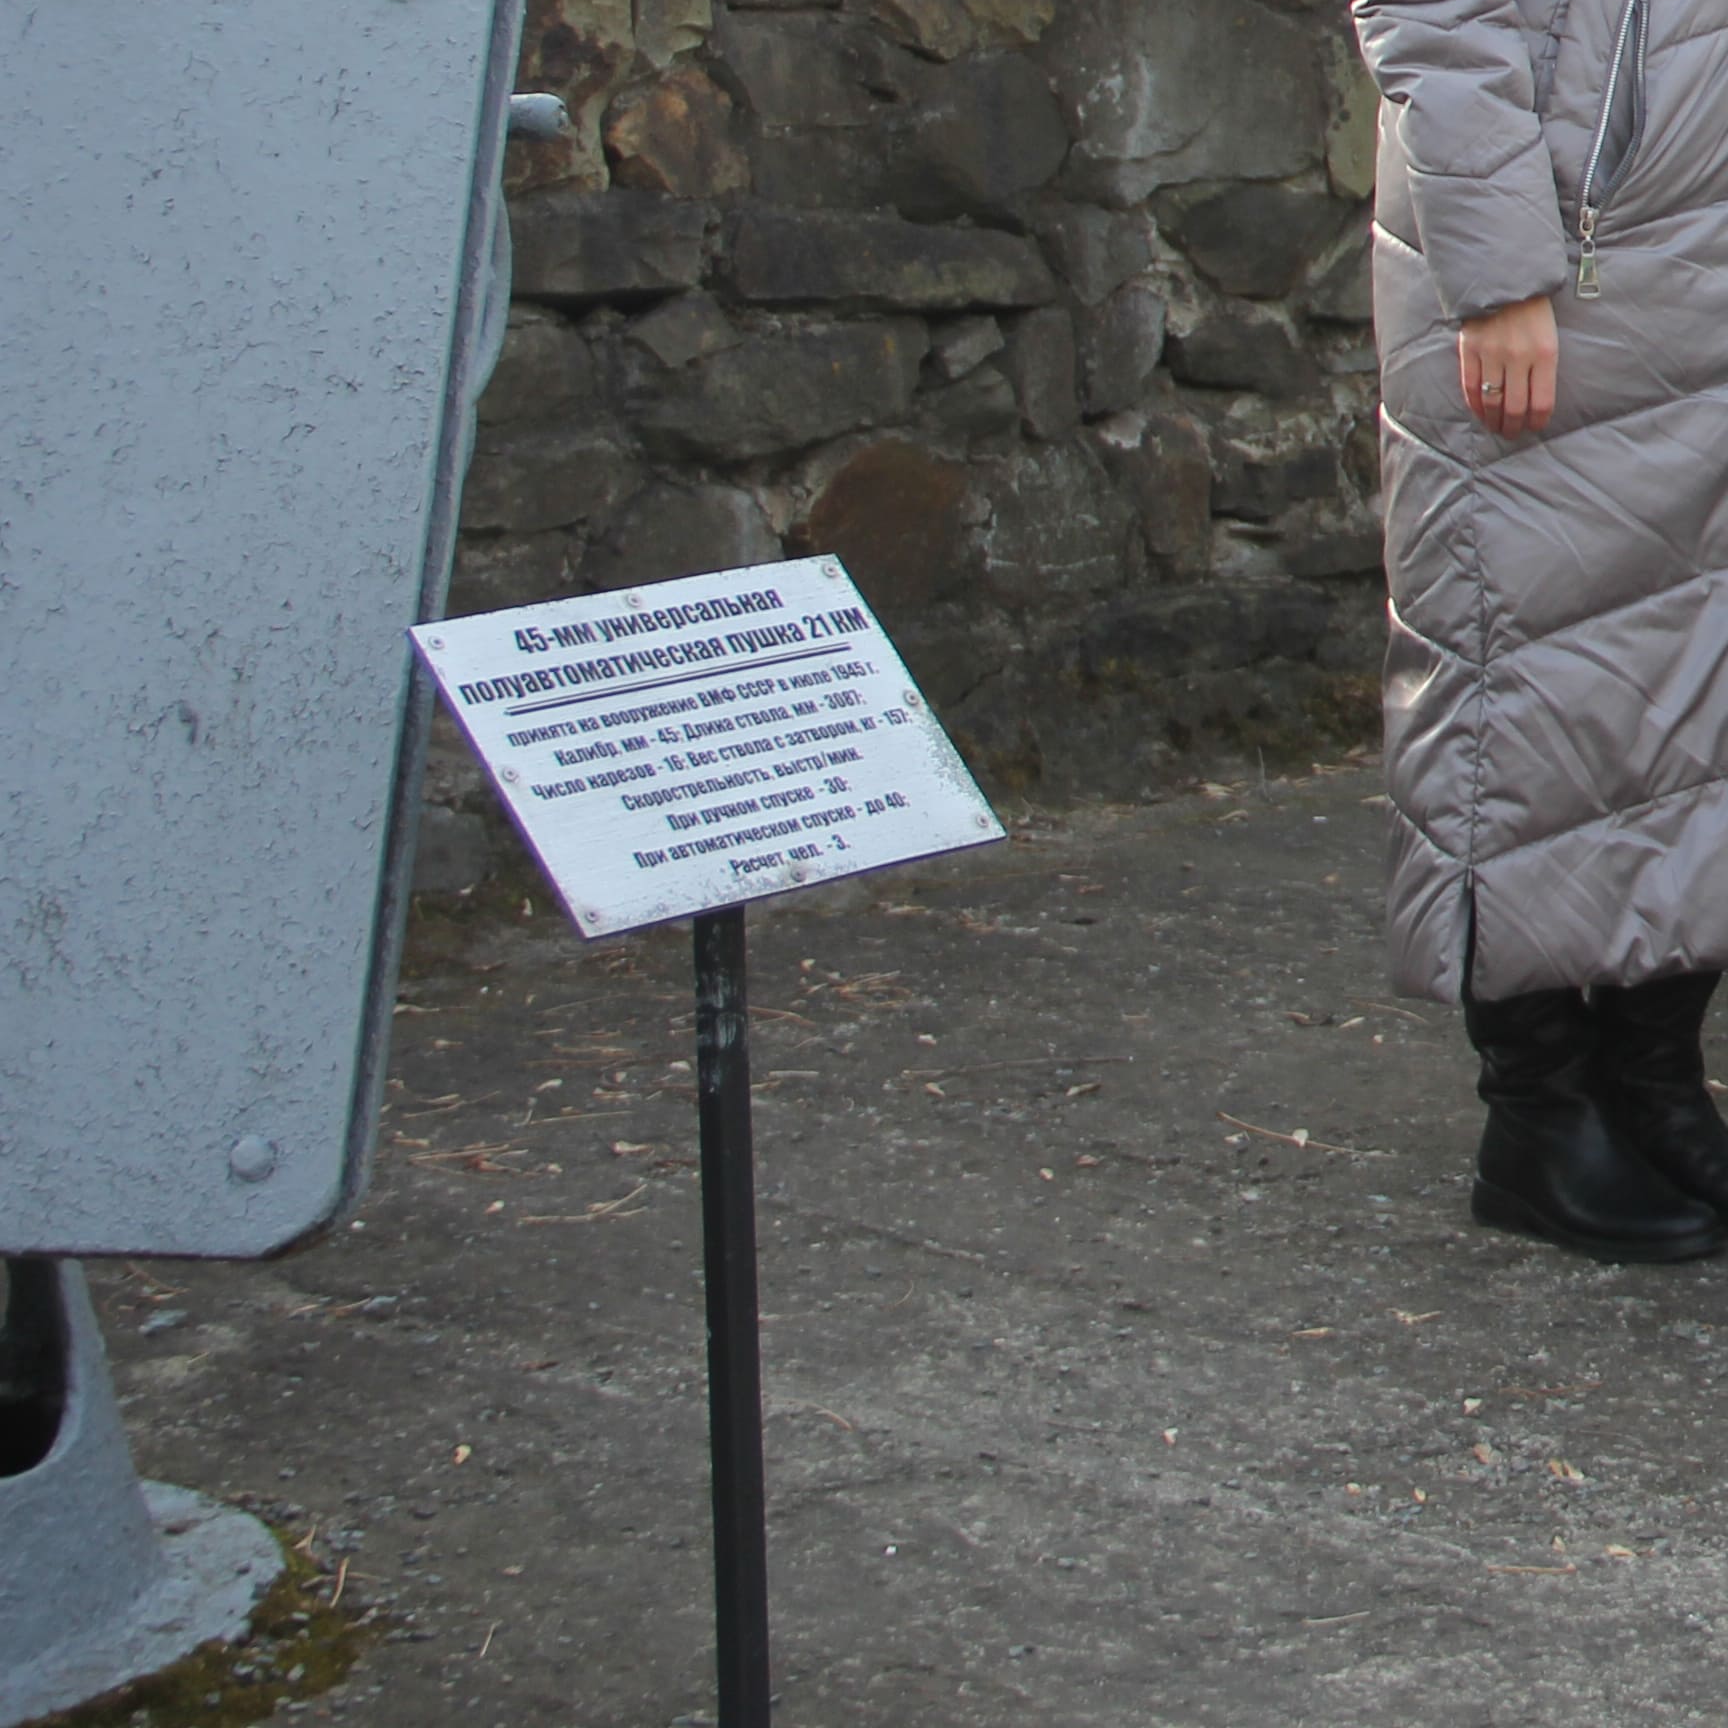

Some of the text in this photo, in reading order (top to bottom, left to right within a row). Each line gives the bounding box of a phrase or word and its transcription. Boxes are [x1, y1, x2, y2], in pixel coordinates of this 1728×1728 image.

[457, 606, 869, 705] полуавтоматическая пушка 21 КМ
[513, 588, 784, 654] 45-мм универсальная
[505, 720, 578, 747] принята
[576, 716, 601, 733] на
[598, 696, 699, 728] вооружение
[696, 686, 737, 708] ВМФ
[734, 677, 775, 700] СССР
[775, 677, 790, 692] в
[787, 669, 832, 689] июле
[829, 660, 867, 681] 1945
[552, 740, 621, 767] Калибр,
[619, 734, 649, 753] мм
[656, 726, 683, 744] 45;
[681, 717, 735, 742] Длина
[733, 705, 793, 729] ствола,
[790, 699, 818, 717] мм
[822, 688, 867, 710] 3087;
[530, 777, 587, 800] Число
[585, 762, 657, 790] нарезов
[662, 753, 687, 772] 16;
[684, 749, 719, 768] Вес
[716, 737, 775, 761] ствола
[772, 734, 786, 749] с
[783, 719, 862, 746] затвором,
[858, 715, 877, 731] кг
[881, 707, 911, 726] 157;
[619, 767, 771, 811] Скорострельность,
[632, 848, 668, 869] При
[666, 817, 802, 861] автоматическом
[799, 804, 856, 829] спуске
[863, 797, 886, 816] до
[883, 790, 910, 809] 40;
[664, 811, 701, 831] При
[698, 798, 760, 825] ручном
[758, 785, 815, 810] спуске
[822, 775, 851, 795] 30;
[728, 851, 785, 877] Расчет,
[786, 842, 824, 862] чел.
[830, 833, 851, 851] 3.
